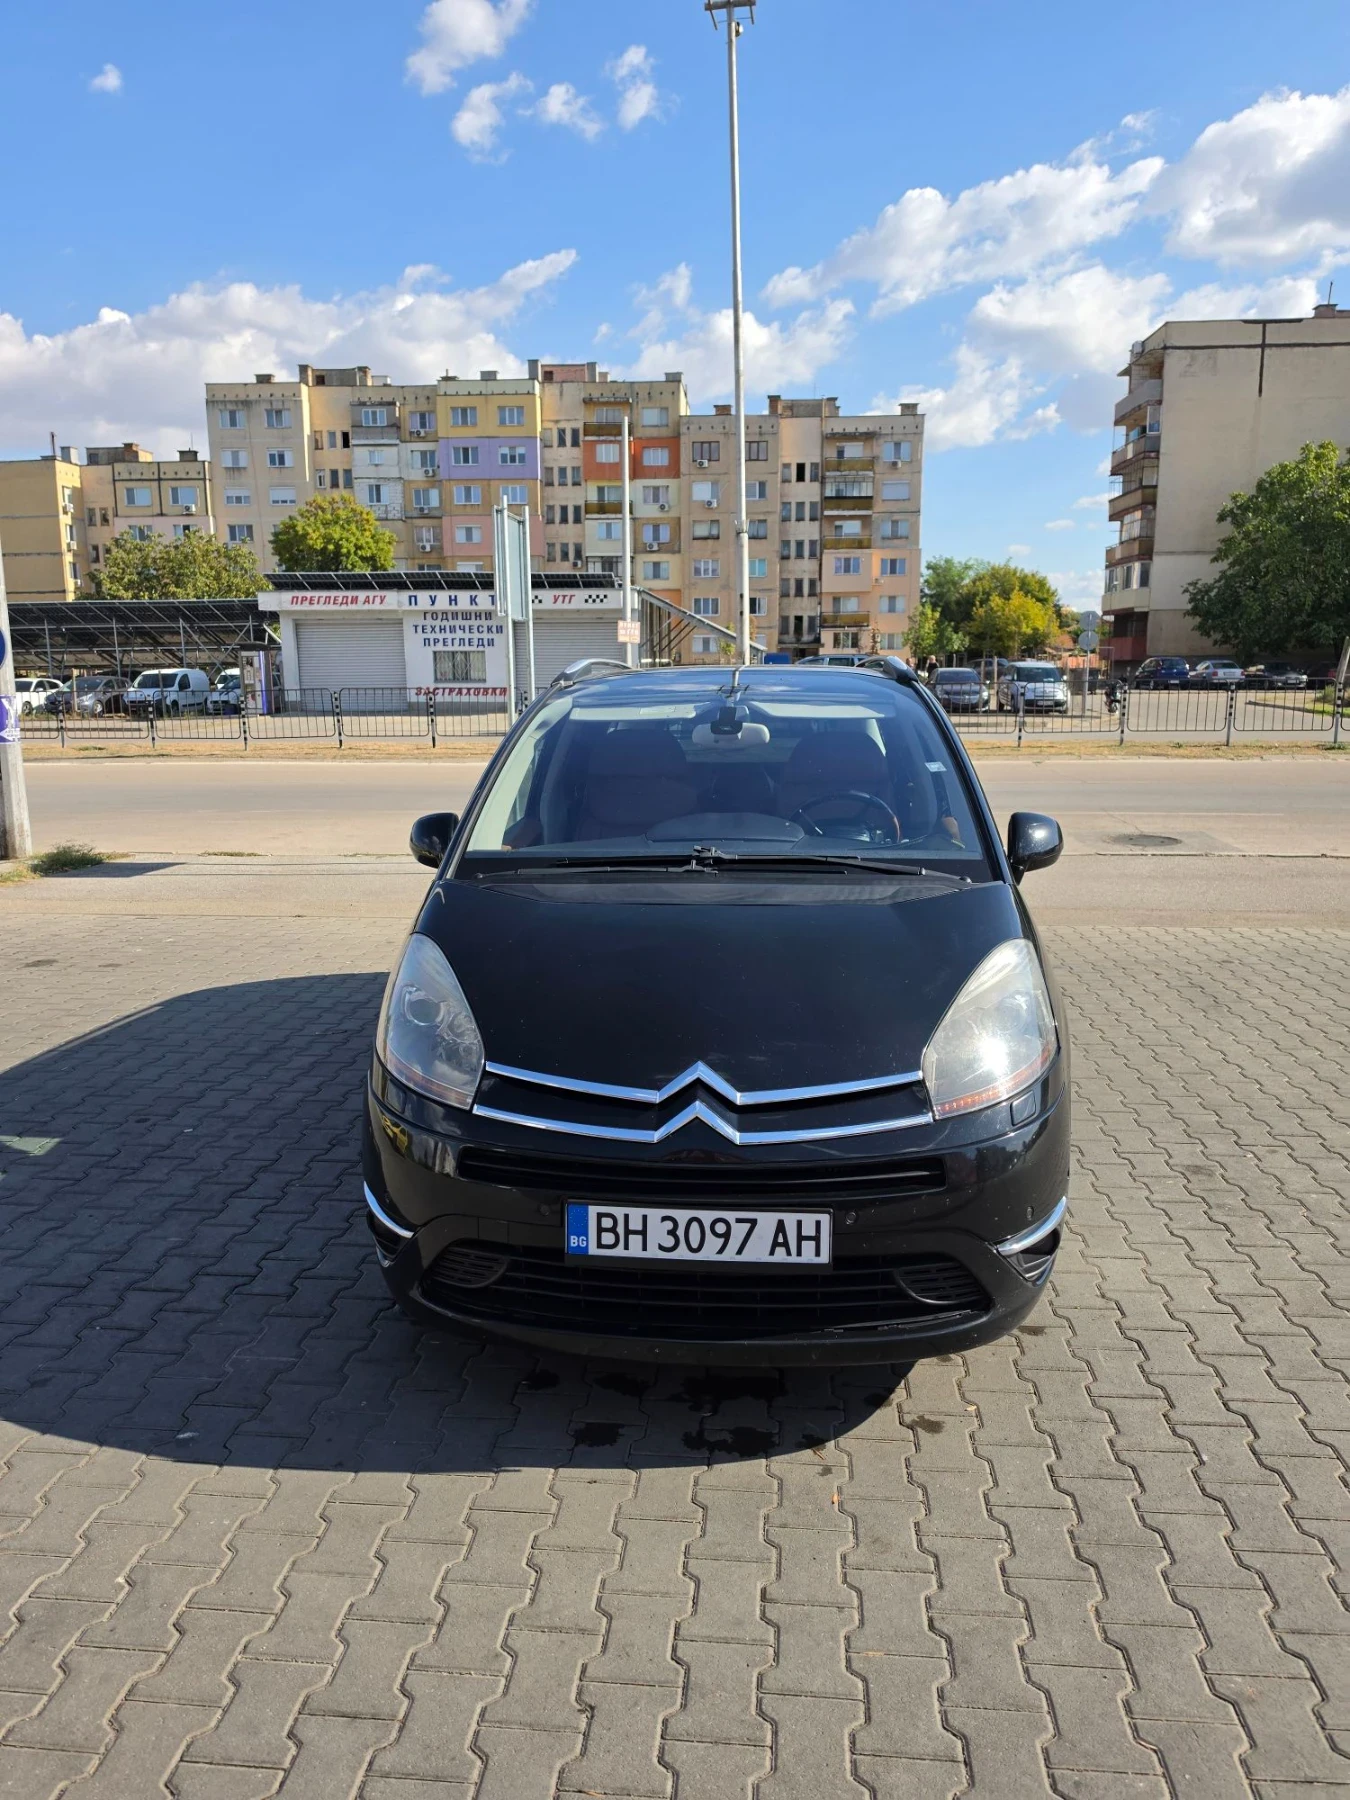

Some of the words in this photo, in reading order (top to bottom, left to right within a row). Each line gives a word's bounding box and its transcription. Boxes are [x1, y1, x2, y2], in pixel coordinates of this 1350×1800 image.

[290, 595, 359, 607] ПРЕГЛЕДИ
[362, 595, 387, 605] АГУ
[408, 594, 496, 606] ПУНКТ
[552, 594, 576, 605] УТГ
[423, 611, 493, 622] ГОДИШНИ
[413, 624, 504, 634] ТЕХНИЧЕСКИ
[423, 637, 495, 648] ПРЕГЛЕДИ
[415, 687, 508, 697] ЗАСТРАХОВКИ
[596, 1212, 648, 1252] BH
[657, 1215, 758, 1256] 3097
[768, 1219, 822, 1258] AH
[570, 1235, 588, 1248] BG
